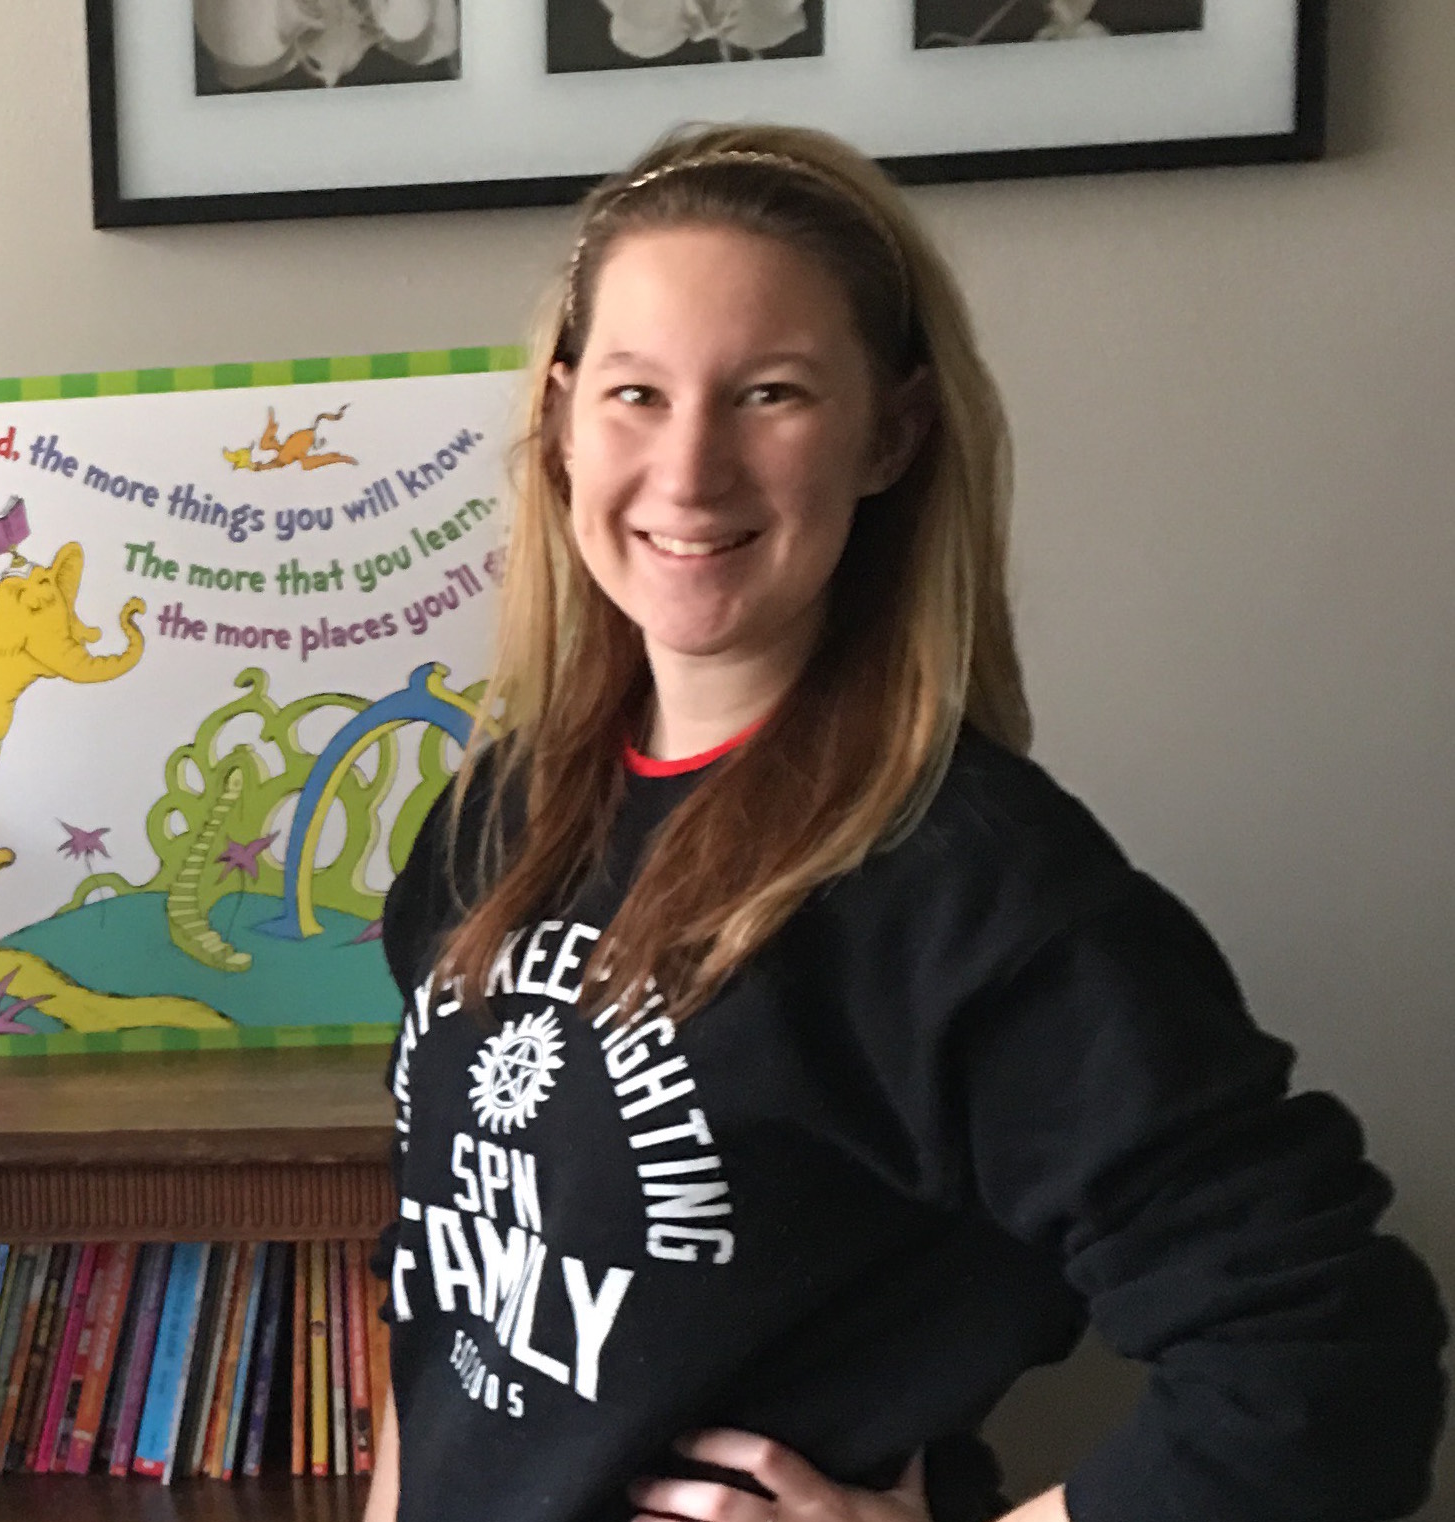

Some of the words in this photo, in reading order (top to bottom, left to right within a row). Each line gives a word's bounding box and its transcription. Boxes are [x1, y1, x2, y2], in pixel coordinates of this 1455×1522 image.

[30, 435, 78, 478] the
[83, 464, 159, 508] more
[168, 483, 265, 543] things
[276, 507, 333, 541] you
[342, 478, 400, 523] will
[396, 428, 484, 499] know.
[124, 541, 180, 581] The
[187, 562, 267, 593] more
[275, 558, 344, 596] that
[354, 545, 412, 593] you
[411, 496, 498, 558] learn.
[157, 602, 208, 641] the
[215, 622, 292, 650] more
[300, 612, 398, 663] places
[404, 564, 484, 635] you'll
[452, 1132, 541, 1234] SPN
